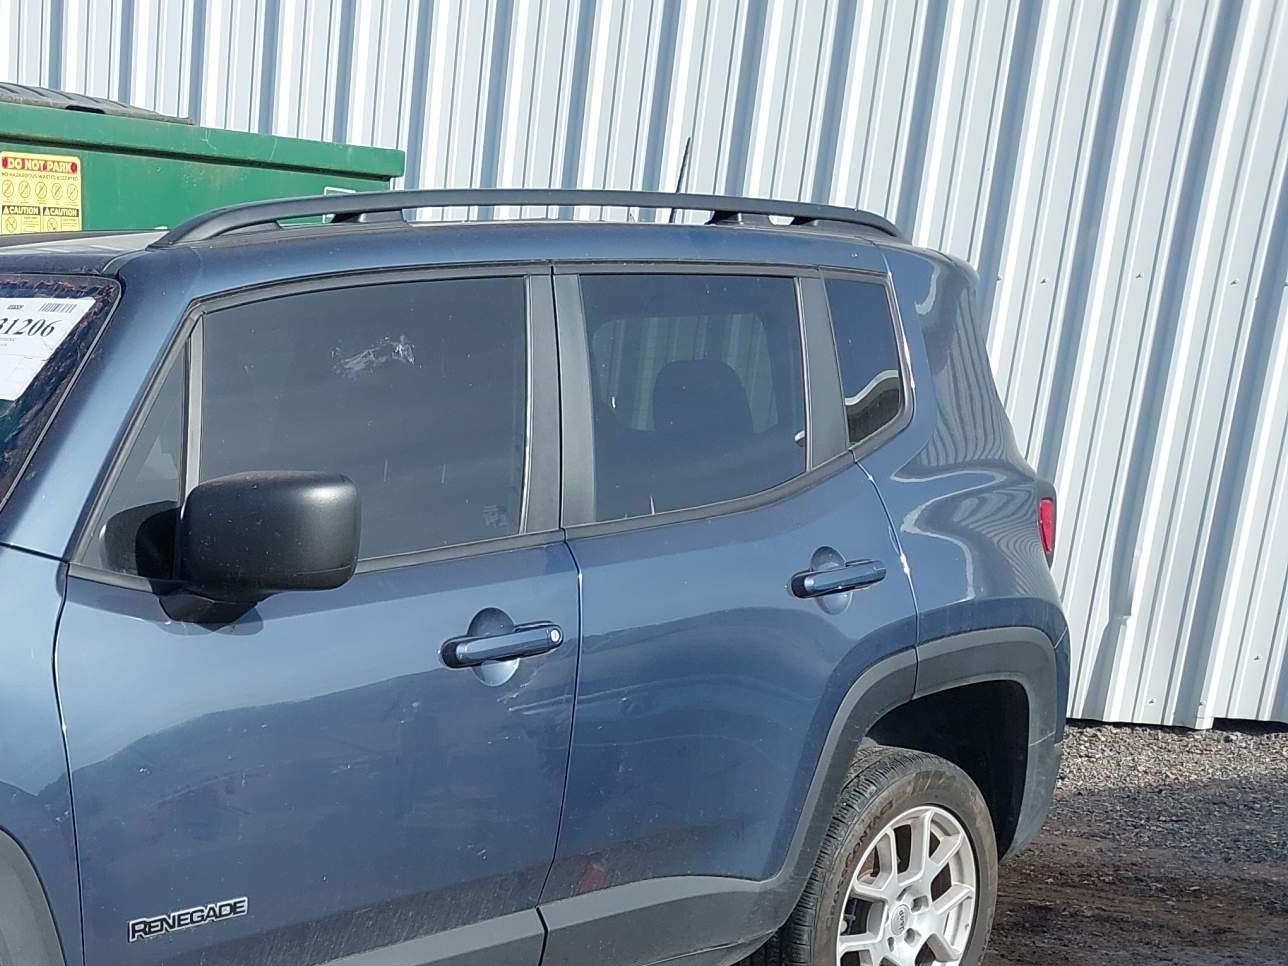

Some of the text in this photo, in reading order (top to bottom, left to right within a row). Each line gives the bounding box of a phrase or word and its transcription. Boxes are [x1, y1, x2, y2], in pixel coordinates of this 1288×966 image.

[7, 157, 71, 173] DO NOT PARK
[10, 206, 39, 215] CAUTION
[51, 208, 77, 217] CAUTION
[128, 896, 249, 943] RENEGADE
